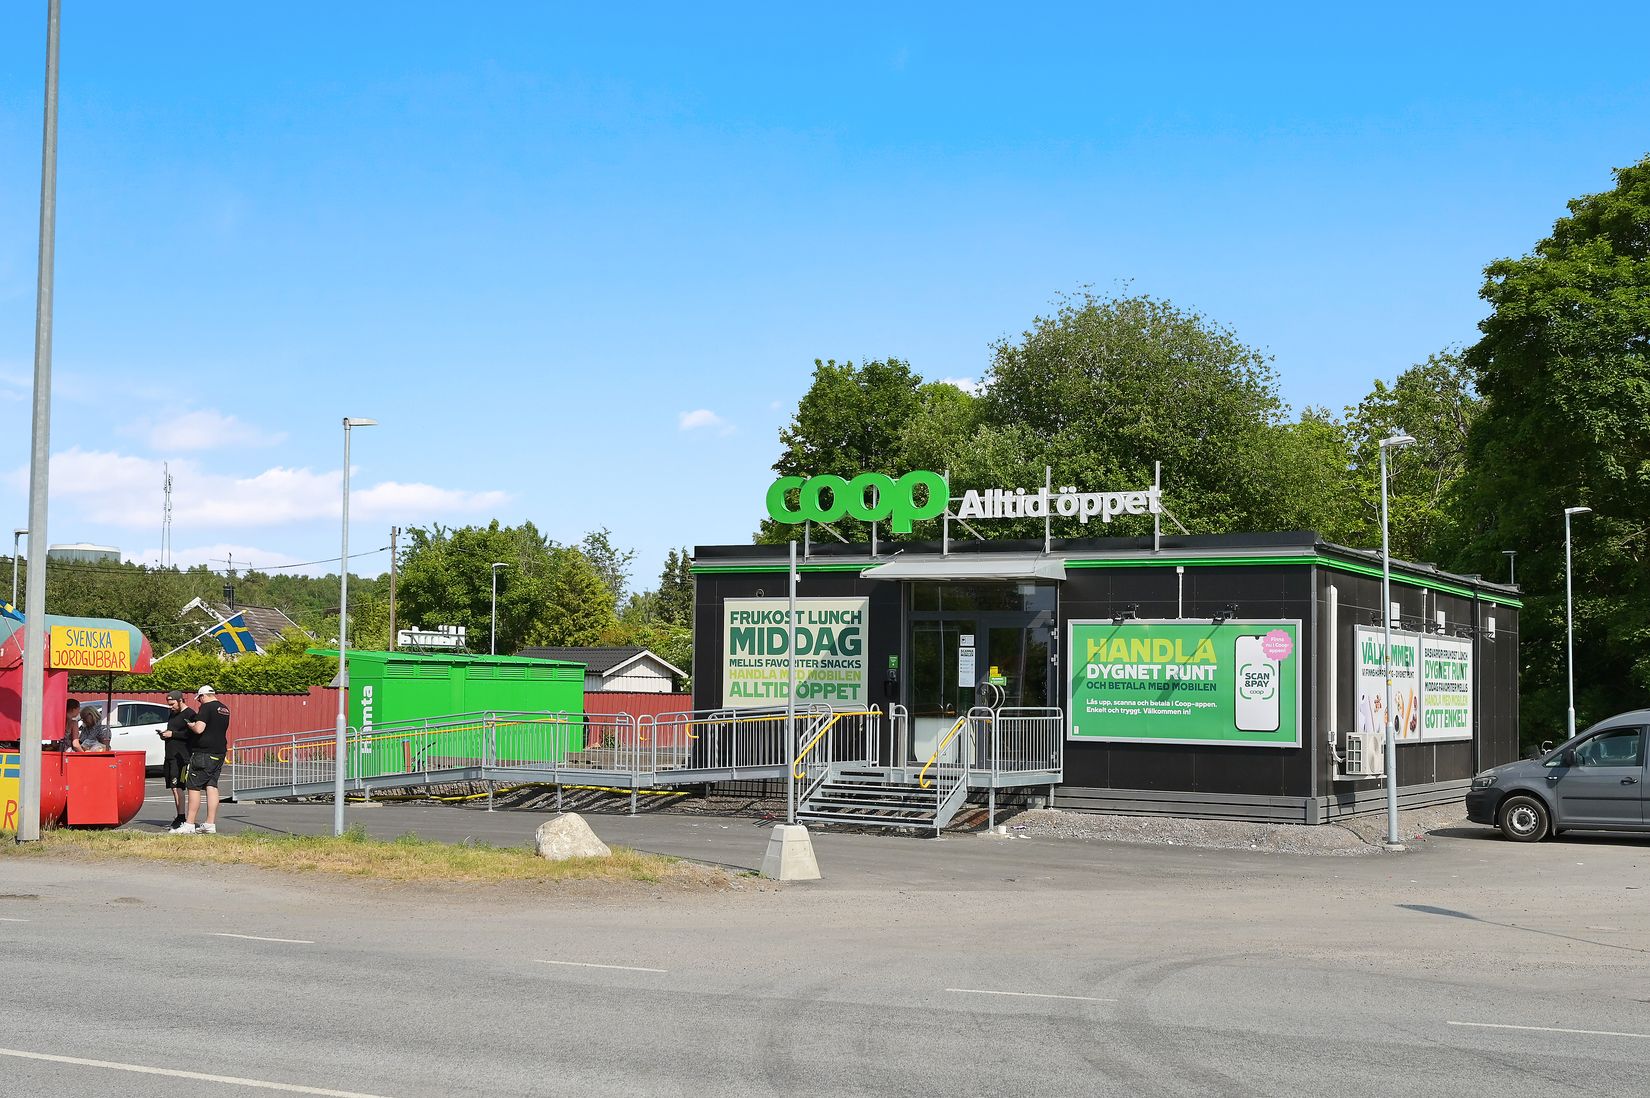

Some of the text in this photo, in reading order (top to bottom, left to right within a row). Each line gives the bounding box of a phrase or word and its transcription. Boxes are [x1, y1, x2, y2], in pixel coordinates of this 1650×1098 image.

[766, 470, 950, 533] coop
[958, 485, 1161, 523] Alltid öppet
[809, 610, 862, 624] LUNCH
[66, 629, 113, 649] SVENSKA
[730, 627, 862, 656] MIDDAG
[53, 650, 127, 668] JORDGUBBAR
[1087, 638, 1217, 663] HANDLA
[1361, 637, 1415, 667] VÄLKMMEN
[729, 659, 862, 668] MELLIS FAVOITER SNACKS
[1087, 664, 1217, 681] DYGNET RUNT
[1424, 660, 1468, 681] DYGNET RUNT
[729, 669, 862, 681] HANDLA MD MOBILEN
[1244, 672, 1270, 680] SCAN
[1244, 680, 1270, 688] &PAY
[729, 681, 862, 700] ALLTID ÖPPET
[1086, 681, 1217, 692] OCH BETALA MED MOBILEN
[1424, 709, 1468, 728] GOTT ENKELT
